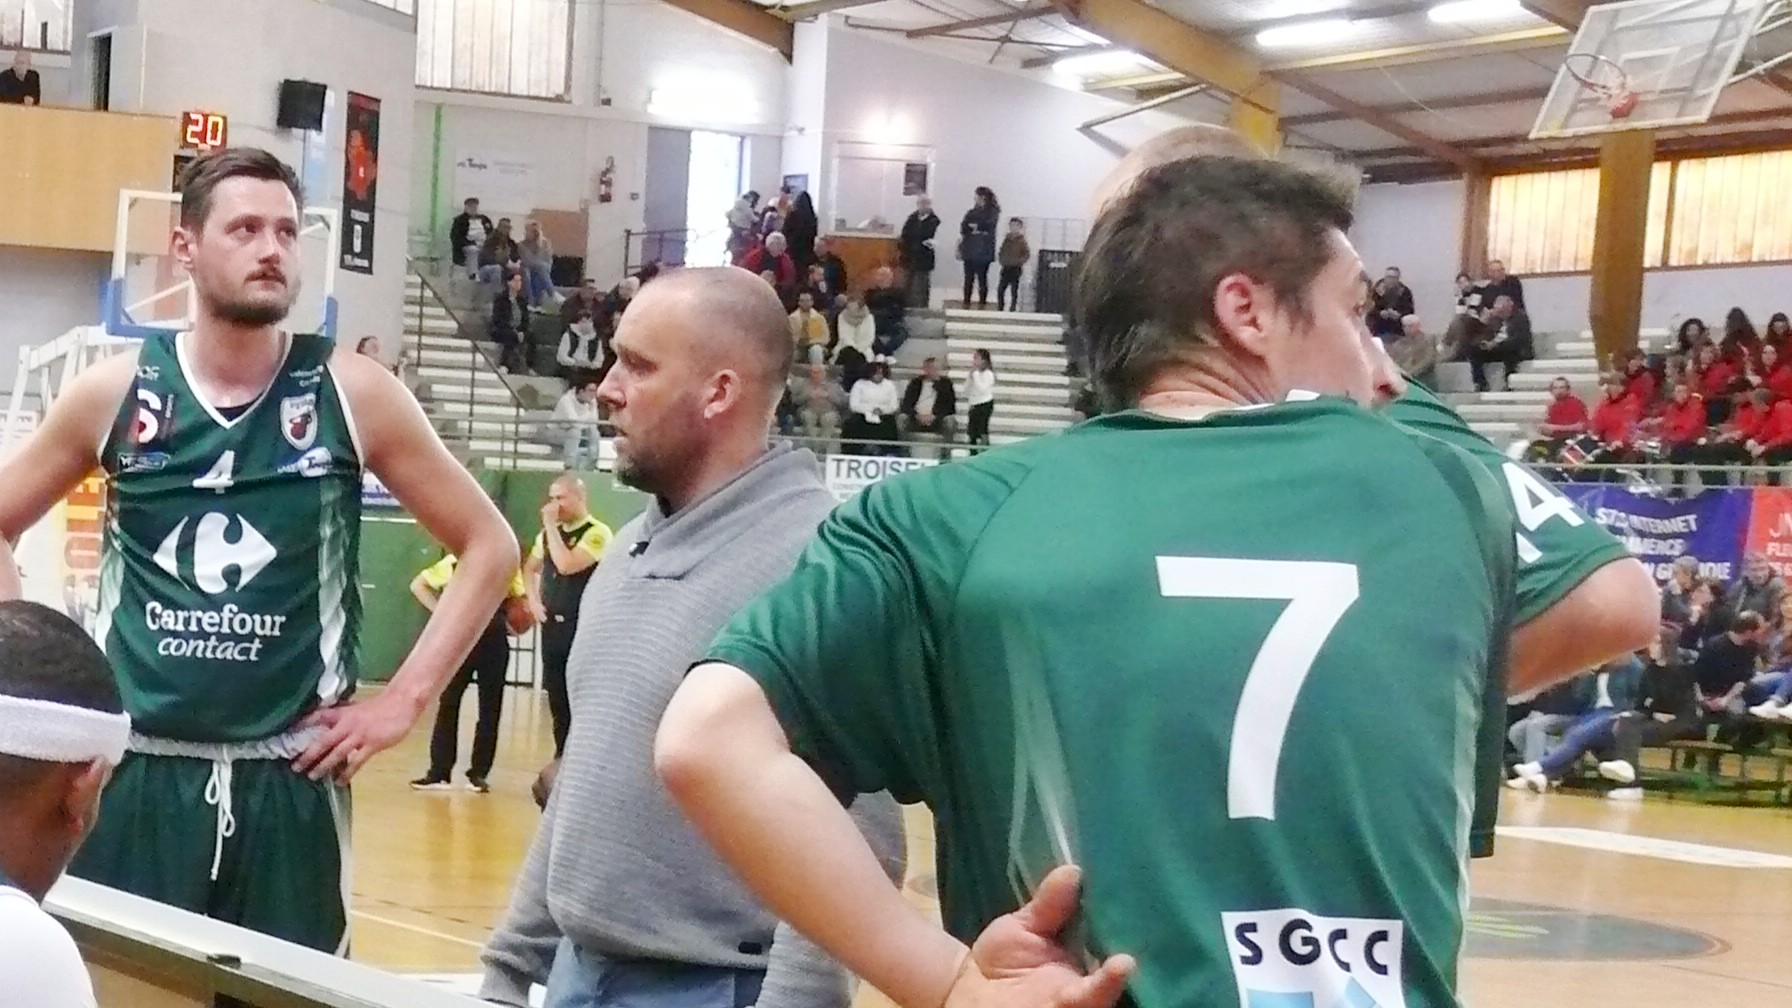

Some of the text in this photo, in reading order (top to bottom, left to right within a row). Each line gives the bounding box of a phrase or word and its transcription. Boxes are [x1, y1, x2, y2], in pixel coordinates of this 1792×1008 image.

[186, 112, 223, 146] 20
[192, 449, 235, 494] 4
[1629, 514, 1698, 534] INTERNET
[145, 600, 287, 637] Carrefour
[158, 635, 263, 661] contact
[1155, 555, 1360, 821] 7
[1234, 917, 1390, 977] SGCC
